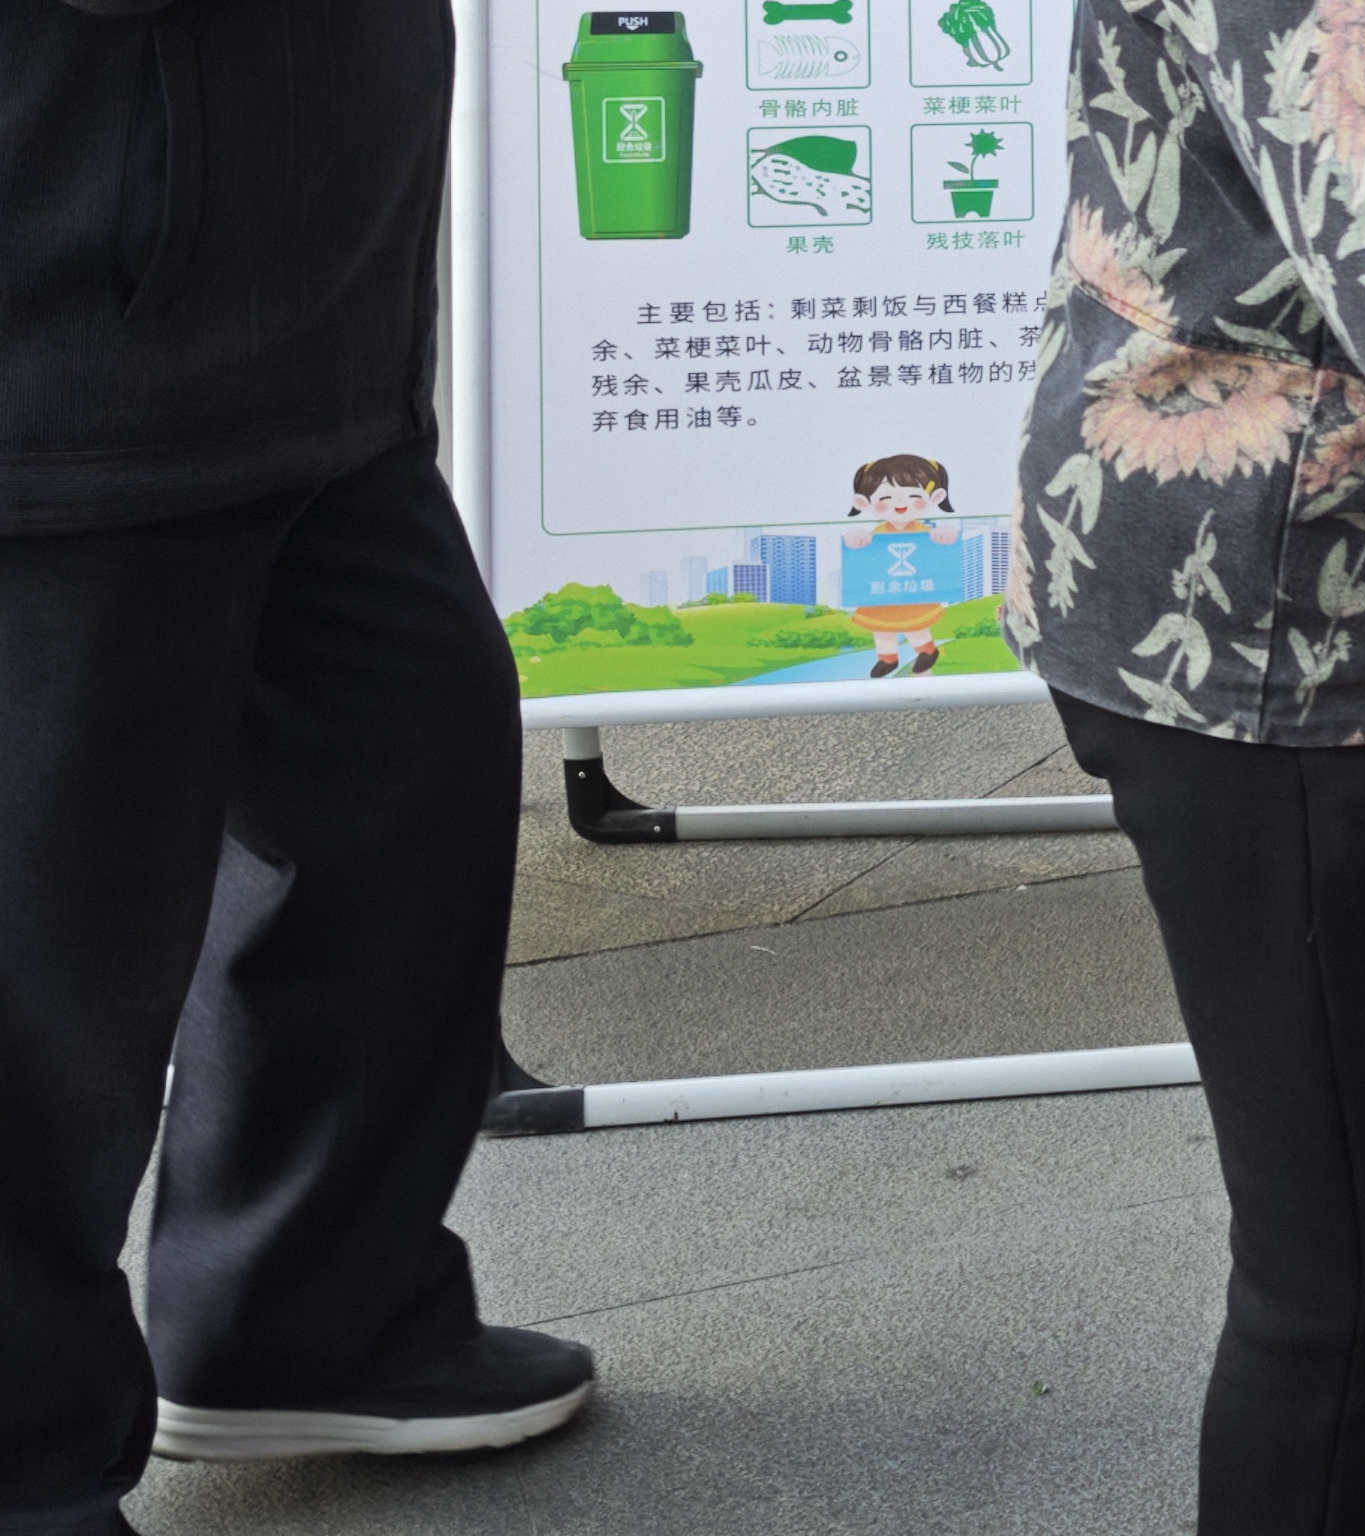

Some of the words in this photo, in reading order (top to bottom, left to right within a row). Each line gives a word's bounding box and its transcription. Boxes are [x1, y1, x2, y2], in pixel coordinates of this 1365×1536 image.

[618, 16, 649, 27] PUSH
[758, 98, 860, 118] 骨骼内脏
[922, 95, 1023, 115] 菜梗菜叶
[786, 234, 835, 255] 果壳
[591, 405, 757, 433] 弃食用油等。
